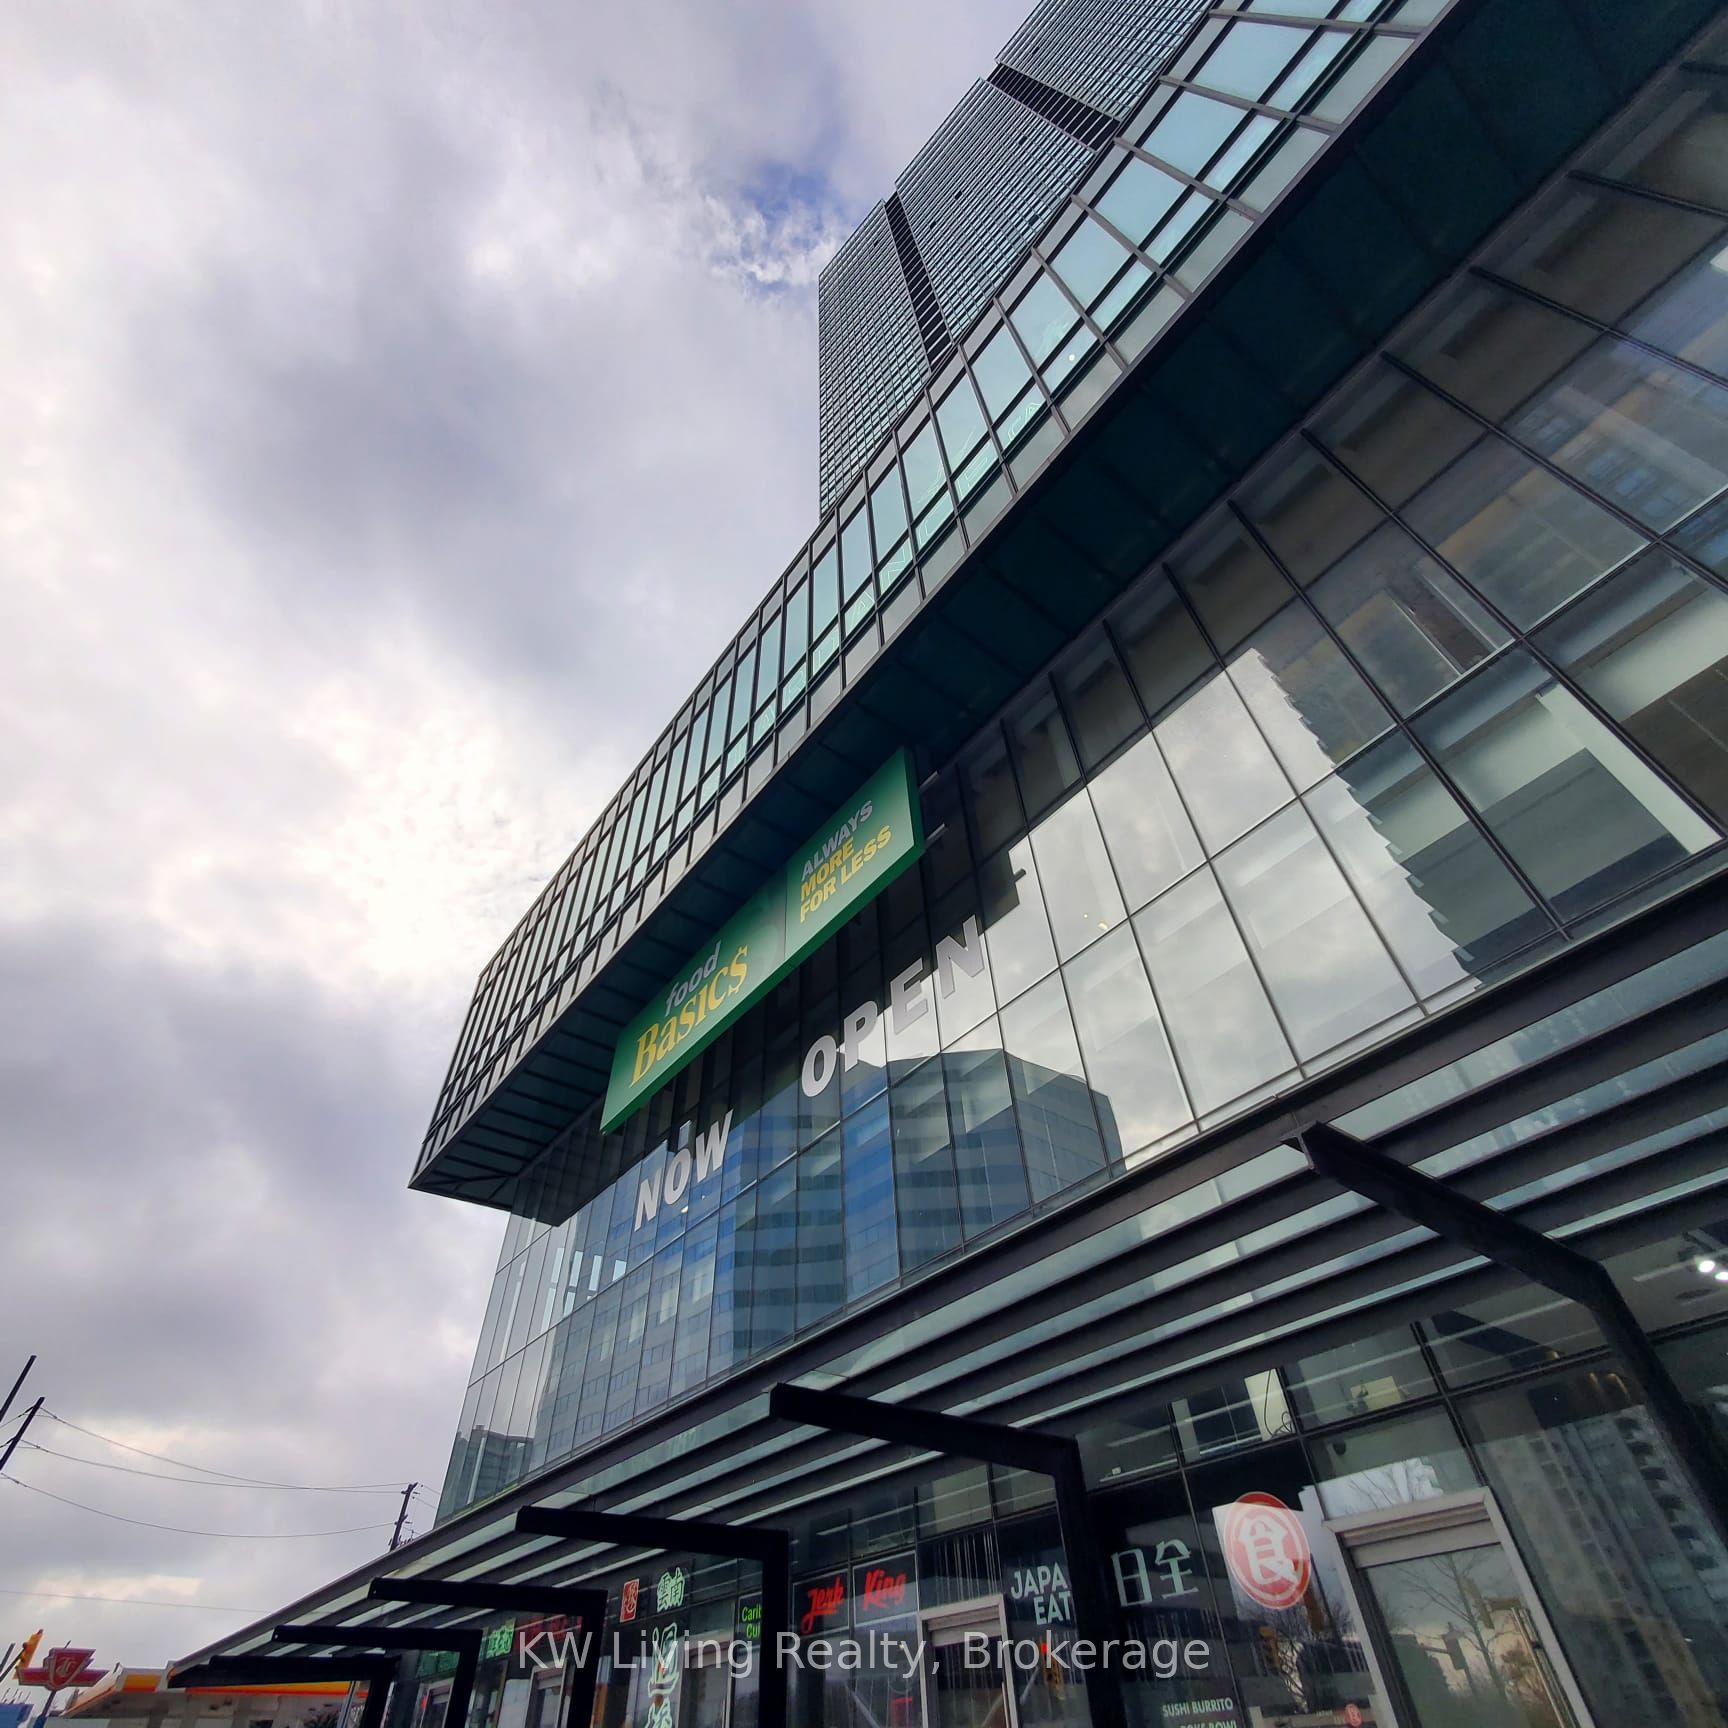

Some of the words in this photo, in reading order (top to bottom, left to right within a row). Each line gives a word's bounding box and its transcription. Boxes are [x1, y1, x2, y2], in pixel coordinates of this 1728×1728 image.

[801, 800, 873, 881] ALWAYS
[801, 836, 855, 902] MORE
[800, 876, 837, 923] FOR
[840, 825, 892, 885] LESS
[665, 940, 721, 1017] food
[634, 1109, 734, 1232] NOW
[801, 914, 985, 1098] OPEN
[862, 1567, 906, 1611] King
[1010, 1562, 1068, 1599] JAPA
[1033, 1590, 1071, 1625] EAT
[1162, 1702, 1191, 1717] SUSHI
[1191, 1697, 1233, 1714] BURRITO
